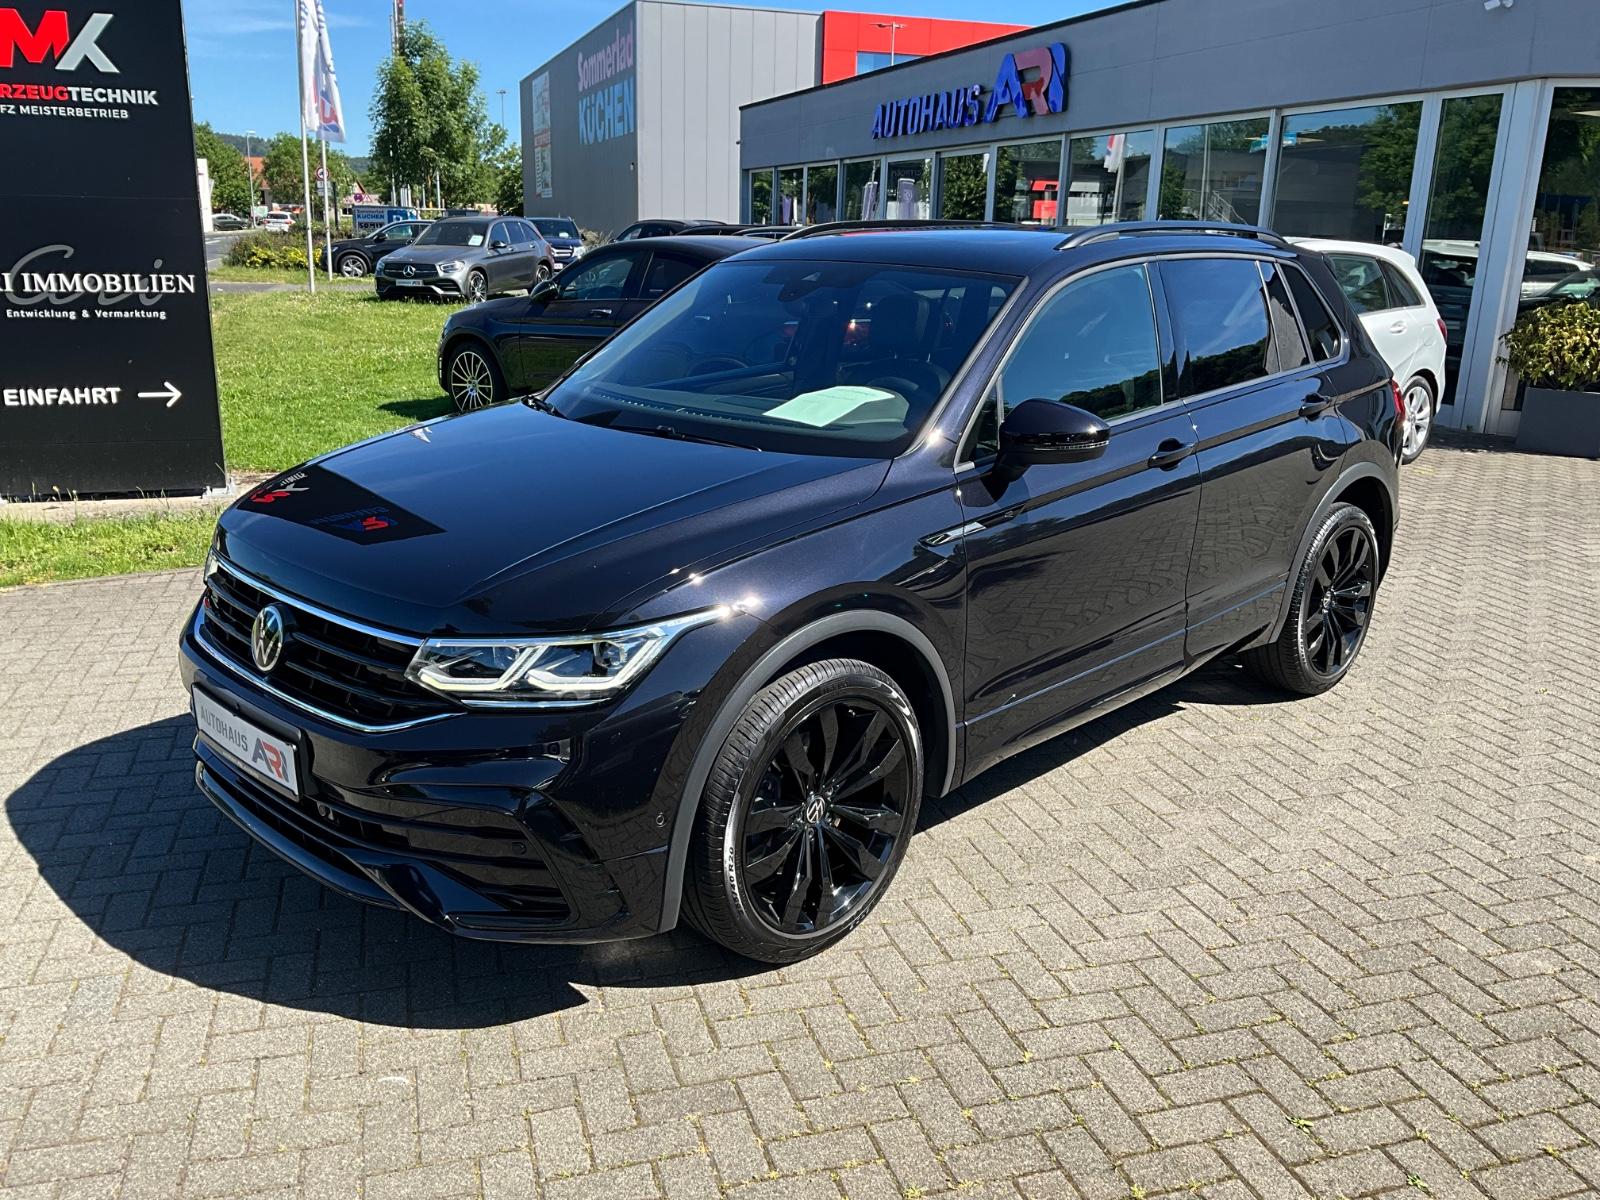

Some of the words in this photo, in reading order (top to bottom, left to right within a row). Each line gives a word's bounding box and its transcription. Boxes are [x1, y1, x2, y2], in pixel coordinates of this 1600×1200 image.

[577, 18, 635, 93] Sommerlad
[19, 105, 129, 119] MEISTERBETRIEB
[578, 75, 635, 146] KÜCHEN
[872, 84, 984, 140] AUTOHAUS
[984, 41, 1071, 124] ARI
[21, 272, 196, 294] IMMOBILIEN
[6, 309, 77, 320] Entwicklung
[81, 309, 91, 319] &
[94, 309, 167, 321] Vermarktung
[3, 386, 121, 407] EINFAHRT
[200, 706, 249, 752] AUTOHAUS
[251, 737, 290, 783] ARI
